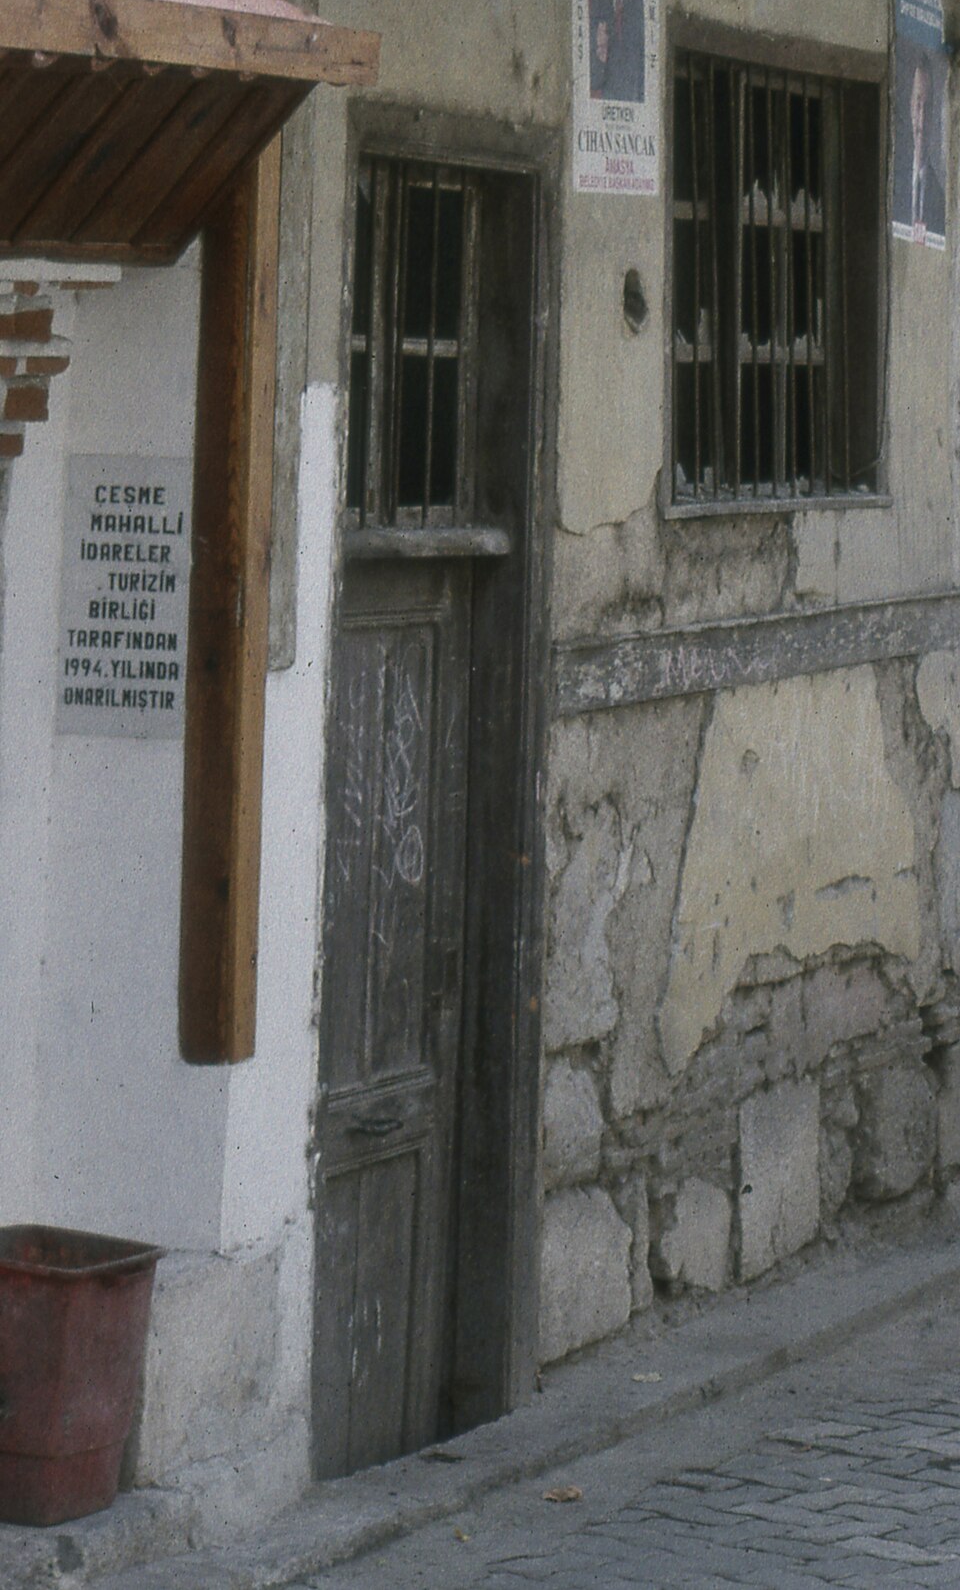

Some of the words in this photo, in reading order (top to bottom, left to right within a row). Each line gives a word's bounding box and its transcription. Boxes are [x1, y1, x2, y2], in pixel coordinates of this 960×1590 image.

[614, 132, 656, 157] SANCAK
[95, 485, 165, 508] ÇEŞME
[90, 511, 183, 534] MAHALLİ
[81, 538, 171, 562] İDARELER
[108, 569, 176, 592] TURİZİM
[89, 597, 155, 621] BİRLİĞİ
[67, 629, 178, 651] TARAFINDAN
[64, 687, 175, 713] ONARILMIŞTIR
